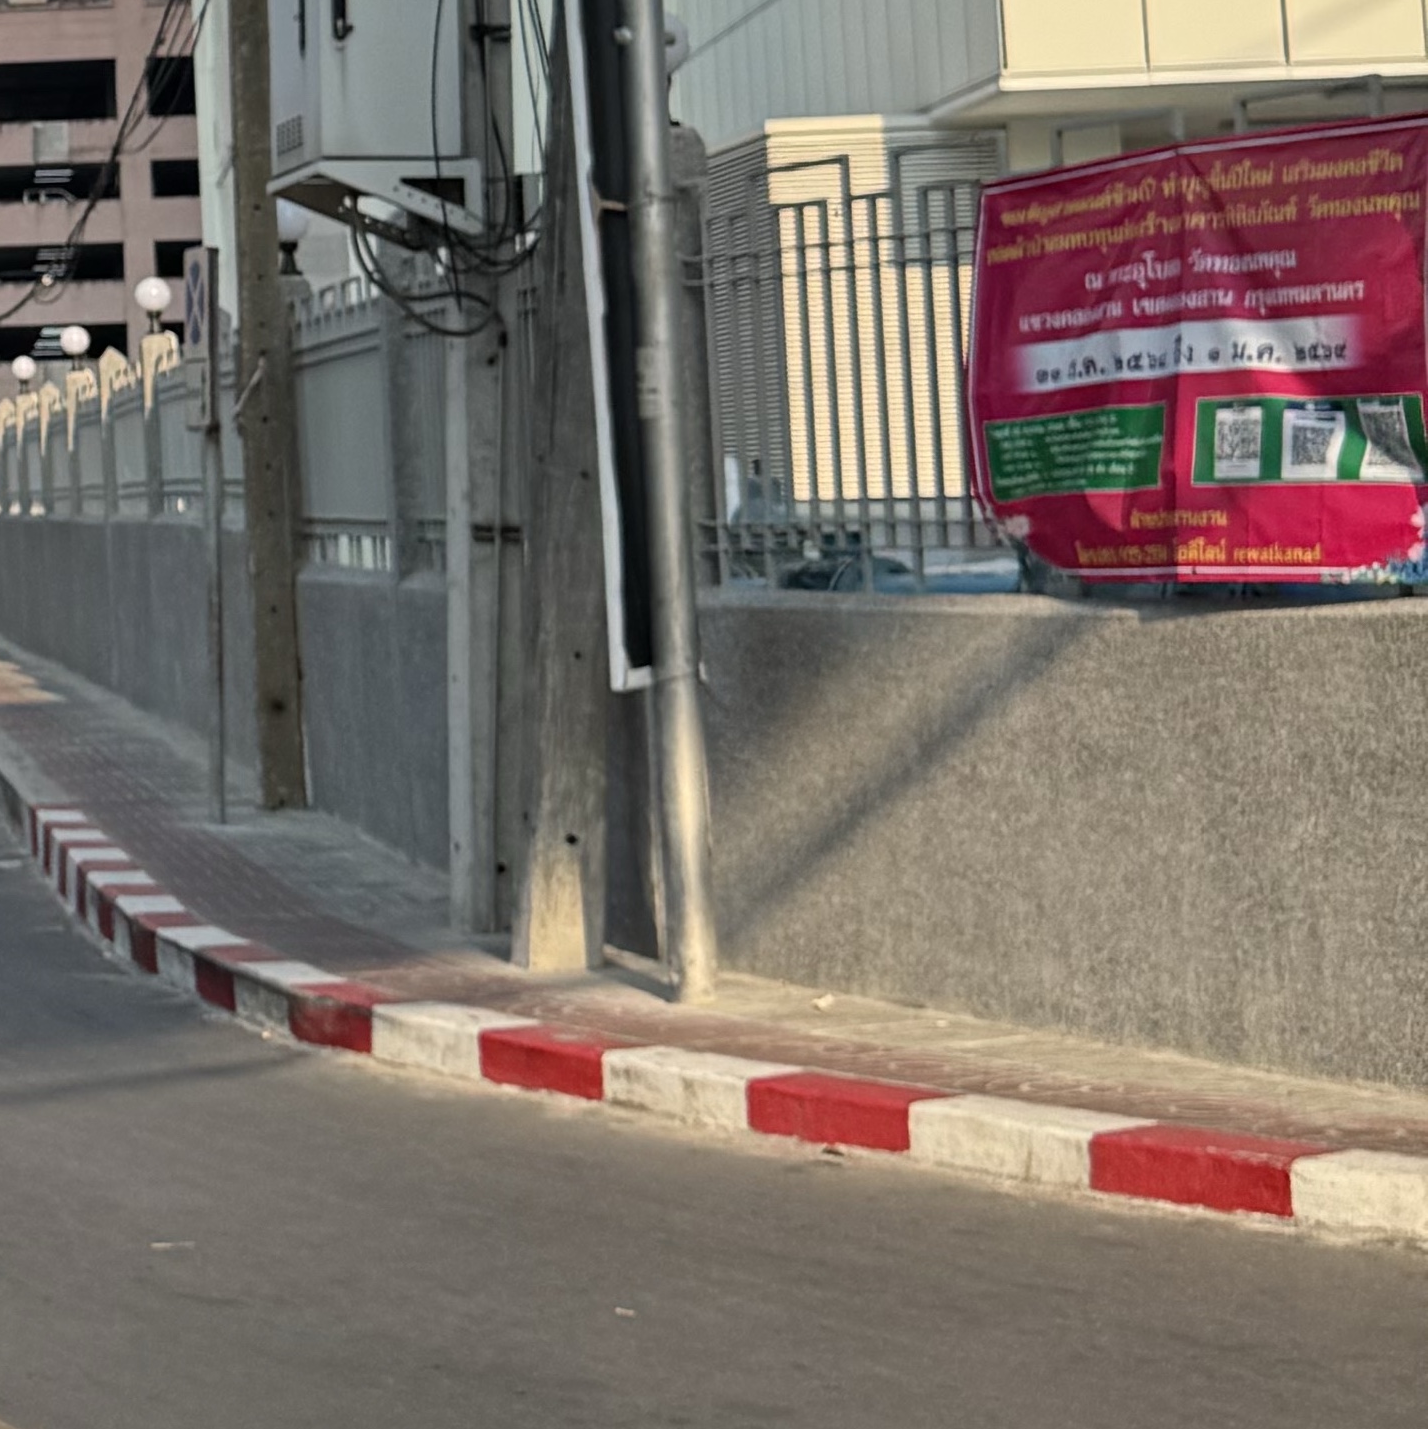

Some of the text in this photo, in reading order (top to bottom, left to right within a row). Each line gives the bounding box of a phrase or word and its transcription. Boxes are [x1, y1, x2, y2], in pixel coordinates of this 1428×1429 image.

[1308, 190, 1421, 222] วัดทองนพคุณ
[1244, 280, 1365, 317] กรุงเทพมหานคร
